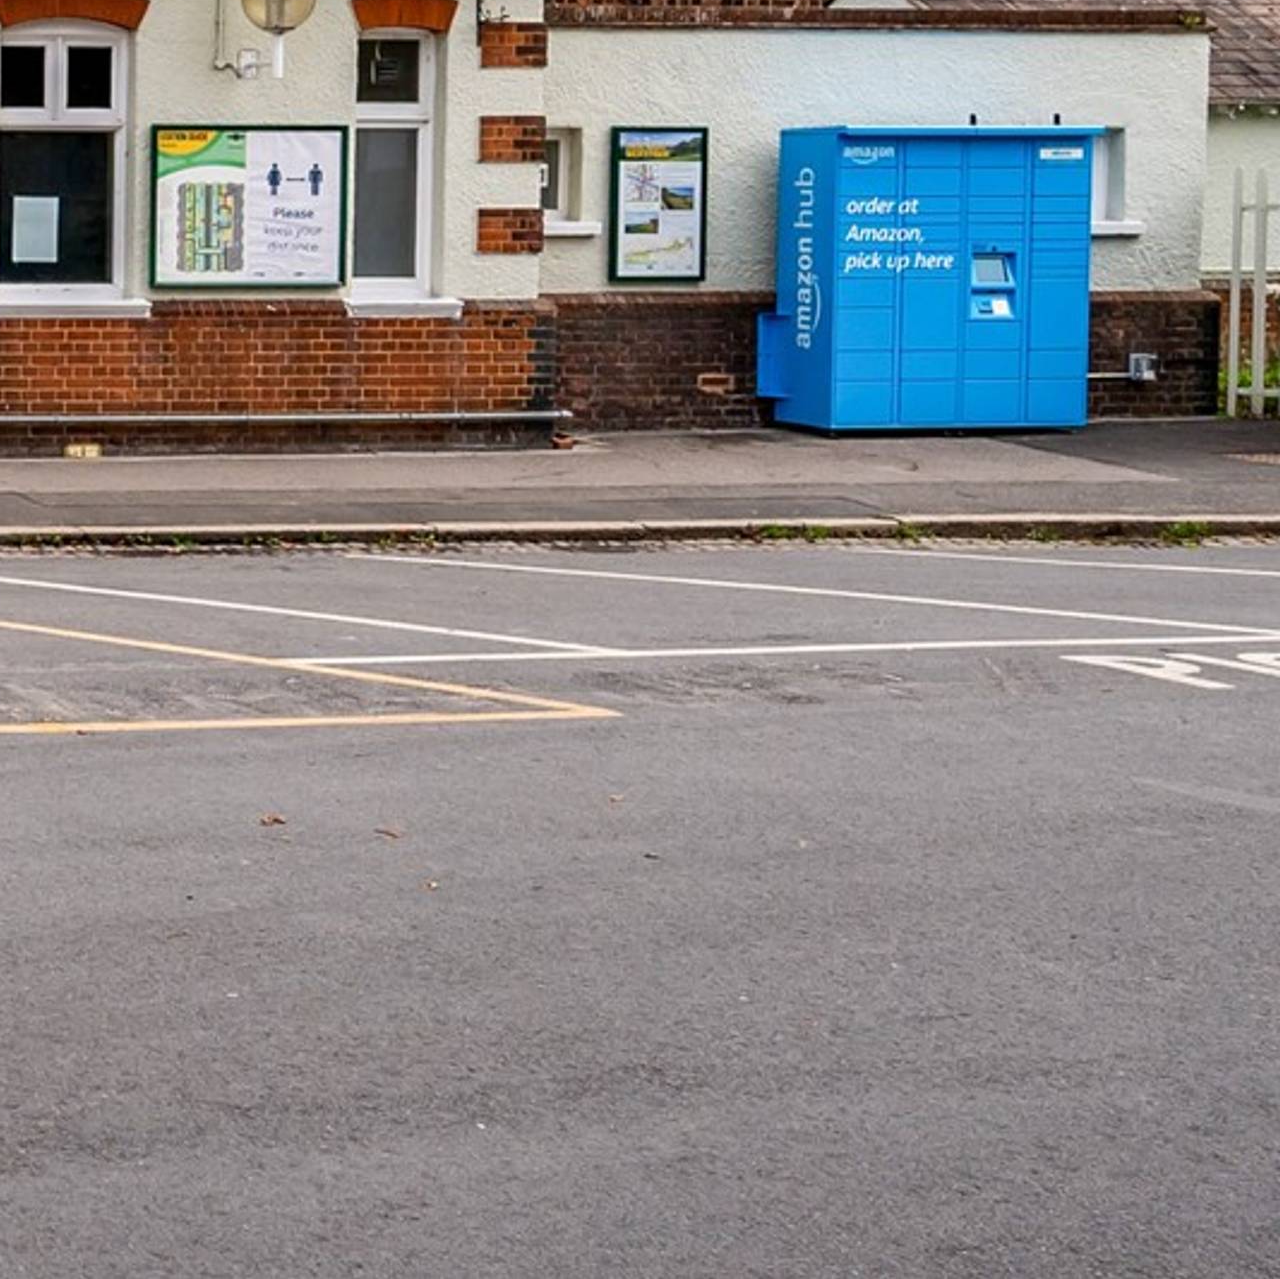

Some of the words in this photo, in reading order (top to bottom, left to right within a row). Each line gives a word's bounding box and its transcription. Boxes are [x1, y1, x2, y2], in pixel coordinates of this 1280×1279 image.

[843, 146, 895, 162] amazon
[794, 167, 816, 229] hub
[845, 197, 894, 214] order
[898, 198, 919, 214] at
[273, 207, 314, 219] Please
[845, 224, 924, 245] Amazon,
[844, 252, 881, 272] pick
[886, 256, 909, 272] up
[913, 252, 954, 269] here
[795, 237, 816, 349] amazon
